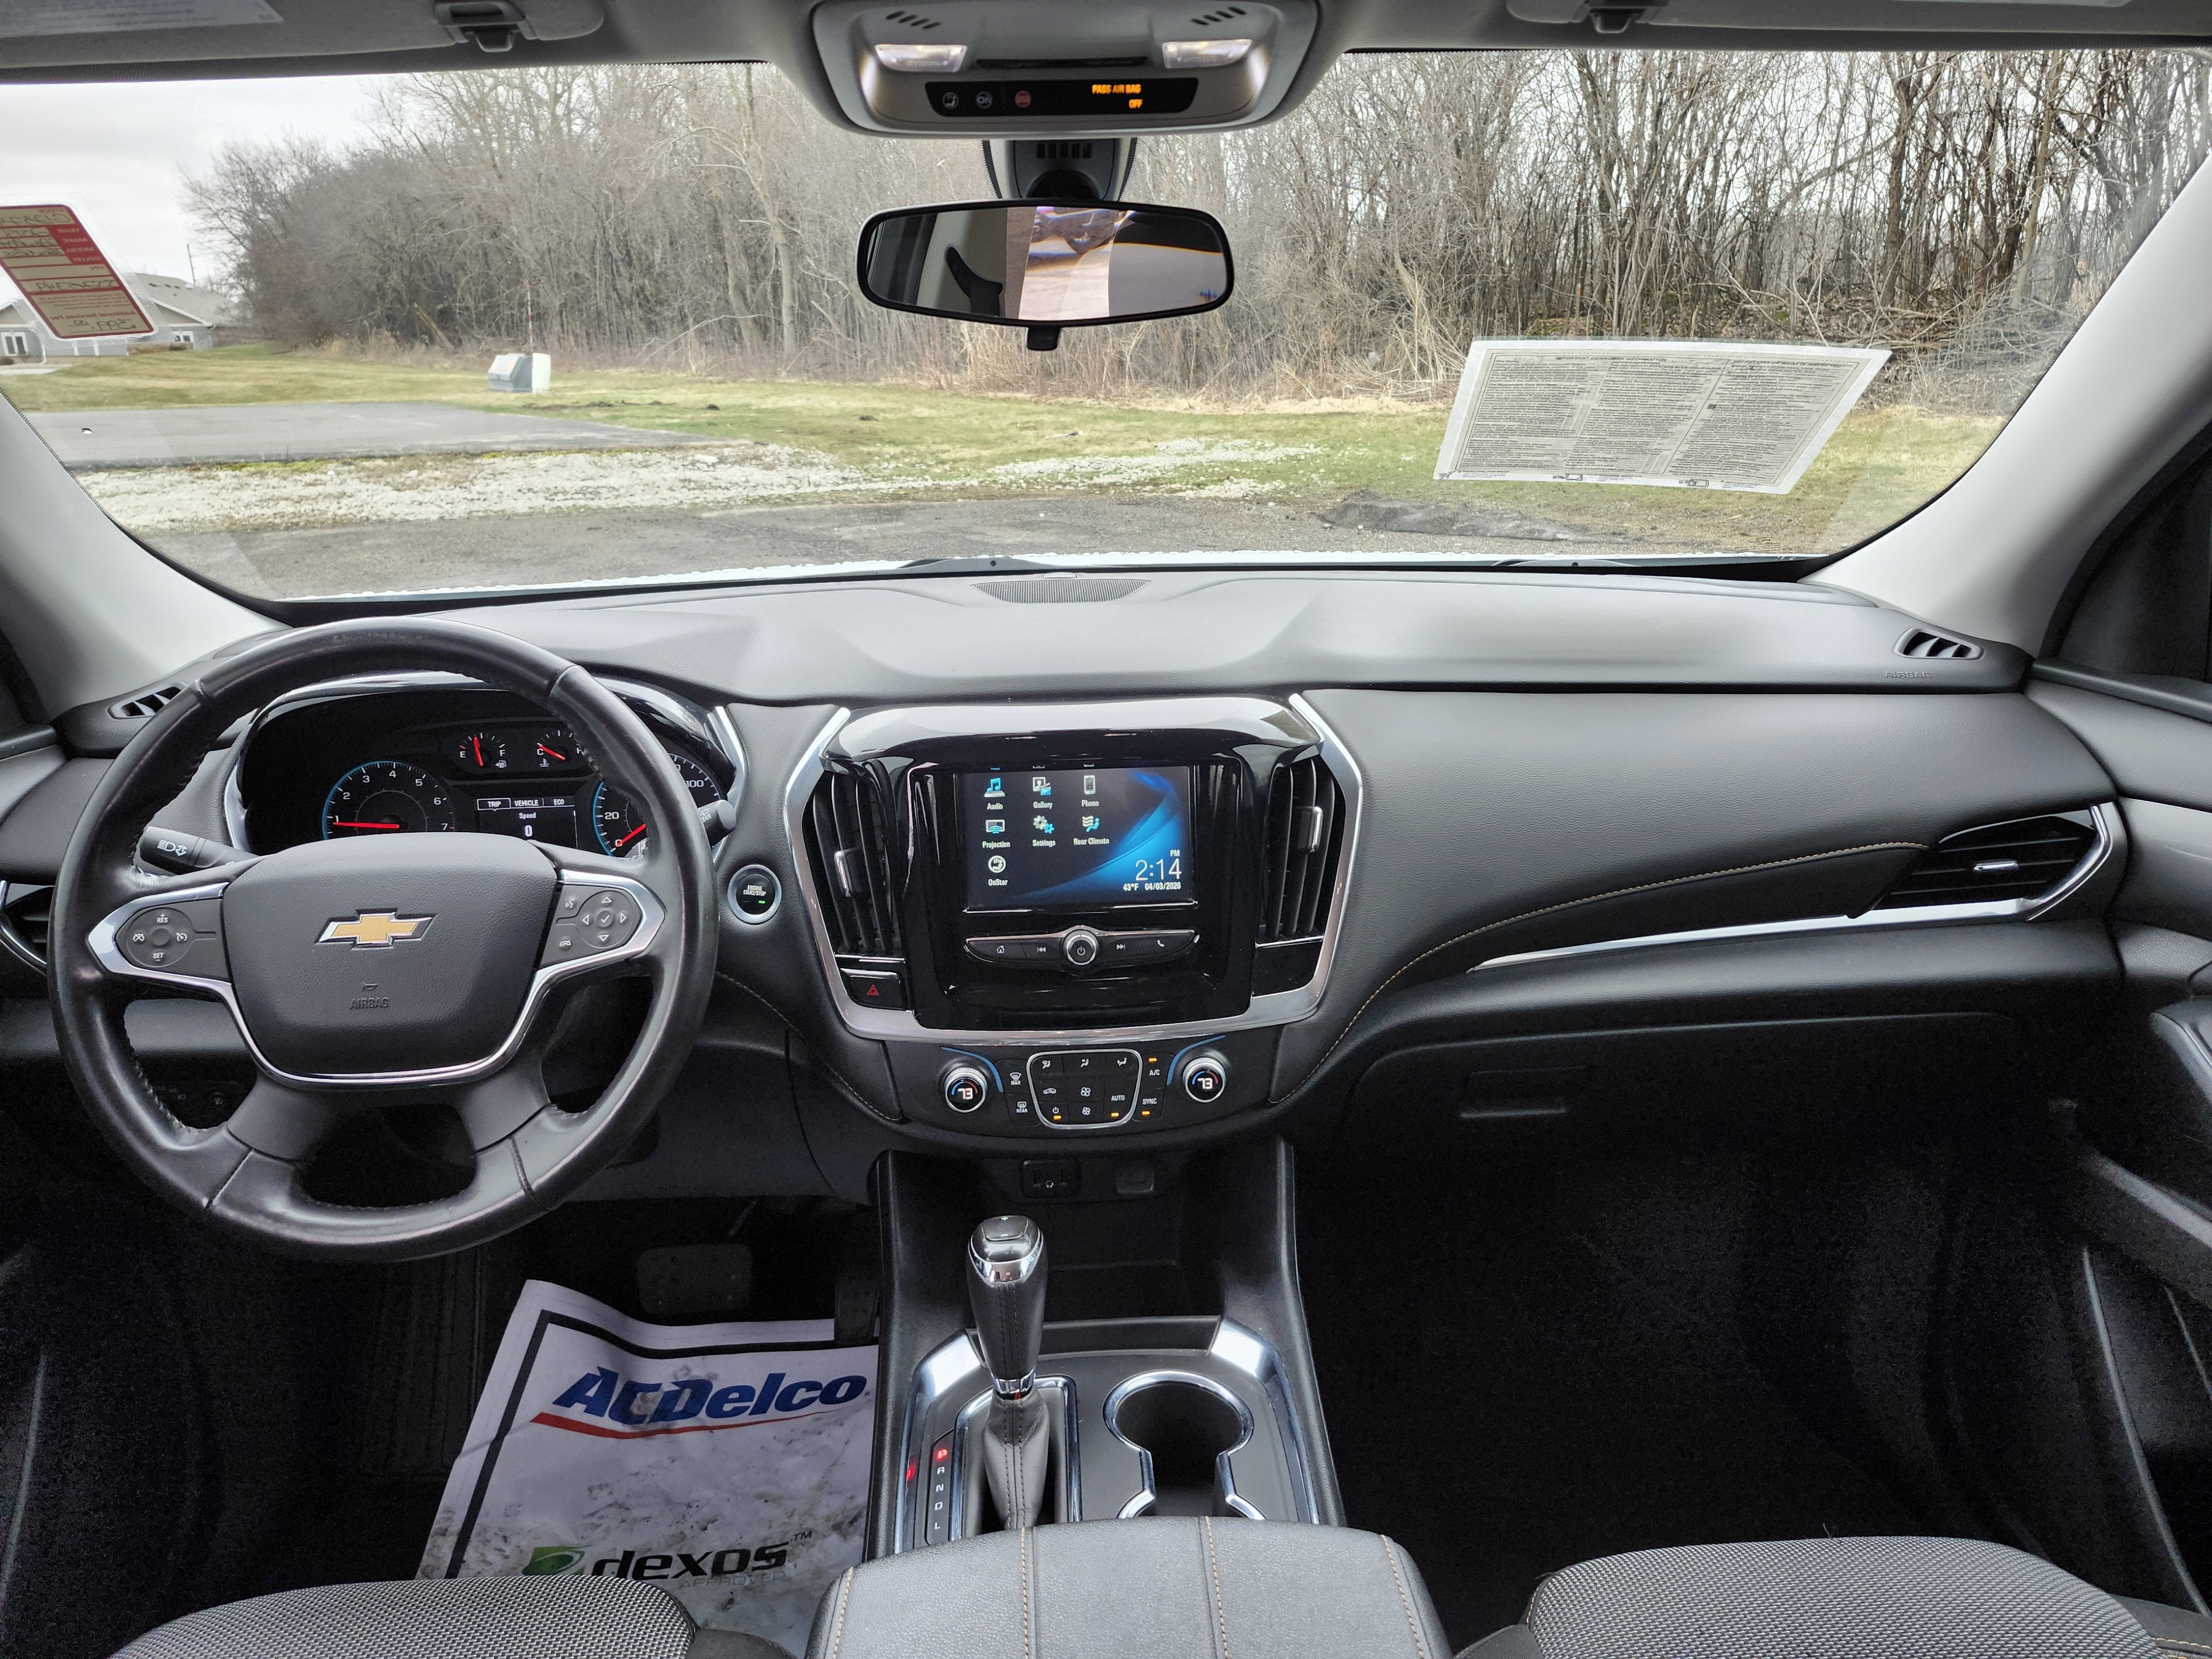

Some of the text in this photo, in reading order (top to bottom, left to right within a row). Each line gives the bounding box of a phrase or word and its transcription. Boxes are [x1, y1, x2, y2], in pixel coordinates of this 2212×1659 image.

[1092, 84, 1142, 94] PASS AIR BAG
[1129, 99, 1143, 109] OFF
[1885, 671, 1932, 679] AIRBAG
[434, 797, 441, 805] 6
[1032, 801, 1053, 810] Gallery
[604, 811, 619, 820] 20
[525, 825, 533, 837] 0
[982, 841, 1011, 849] Projection
[1032, 839, 1056, 847] Settings
[1170, 849, 1180, 857] PM
[1135, 858, 1182, 881] 2:14
[1123, 881, 1182, 891] 43°F 04/03/2026
[350, 997, 389, 1009] AIRBAG
[1197, 1077, 1213, 1089] 73
[958, 1087, 973, 1100] 73
[552, 1365, 867, 1425] ACDelco
[937, 1449, 948, 1460] P
[937, 1466, 945, 1475] R
[936, 1483, 944, 1493] N
[935, 1501, 943, 1511] D
[935, 1521, 941, 1530] L
[592, 1541, 789, 1580] dexos
[679, 1571, 786, 1589] APPROVED
